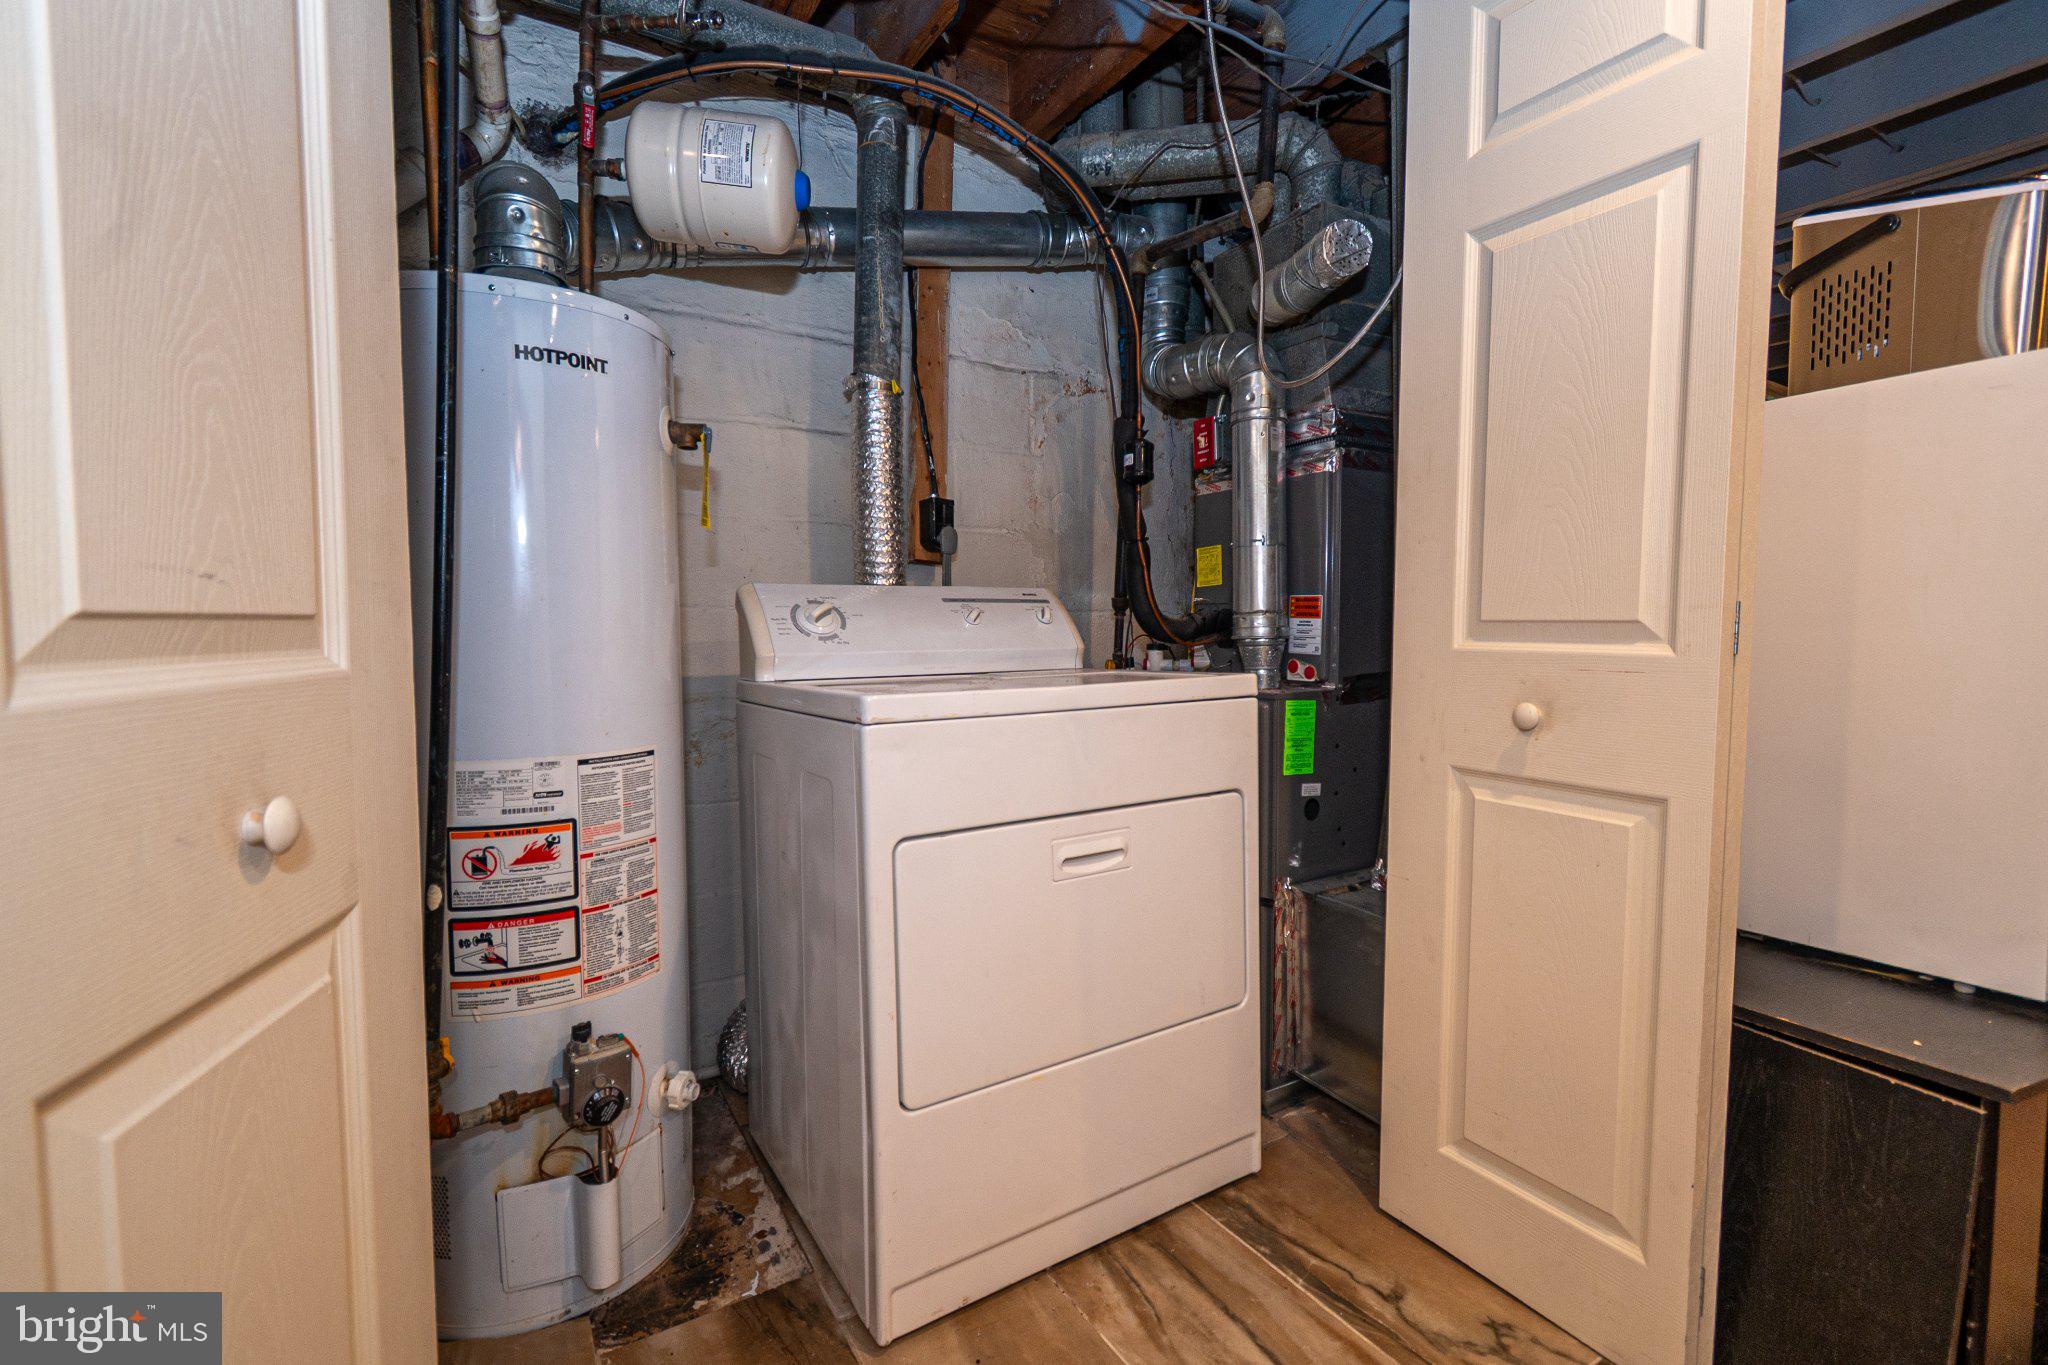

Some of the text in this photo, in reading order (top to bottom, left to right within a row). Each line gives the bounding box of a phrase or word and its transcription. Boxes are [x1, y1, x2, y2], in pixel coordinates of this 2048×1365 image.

[514, 343, 608, 374] HOTPOINT
[493, 829, 539, 837] WARNING
[497, 918, 535, 928] DANGER
[501, 976, 540, 986] WARNING
